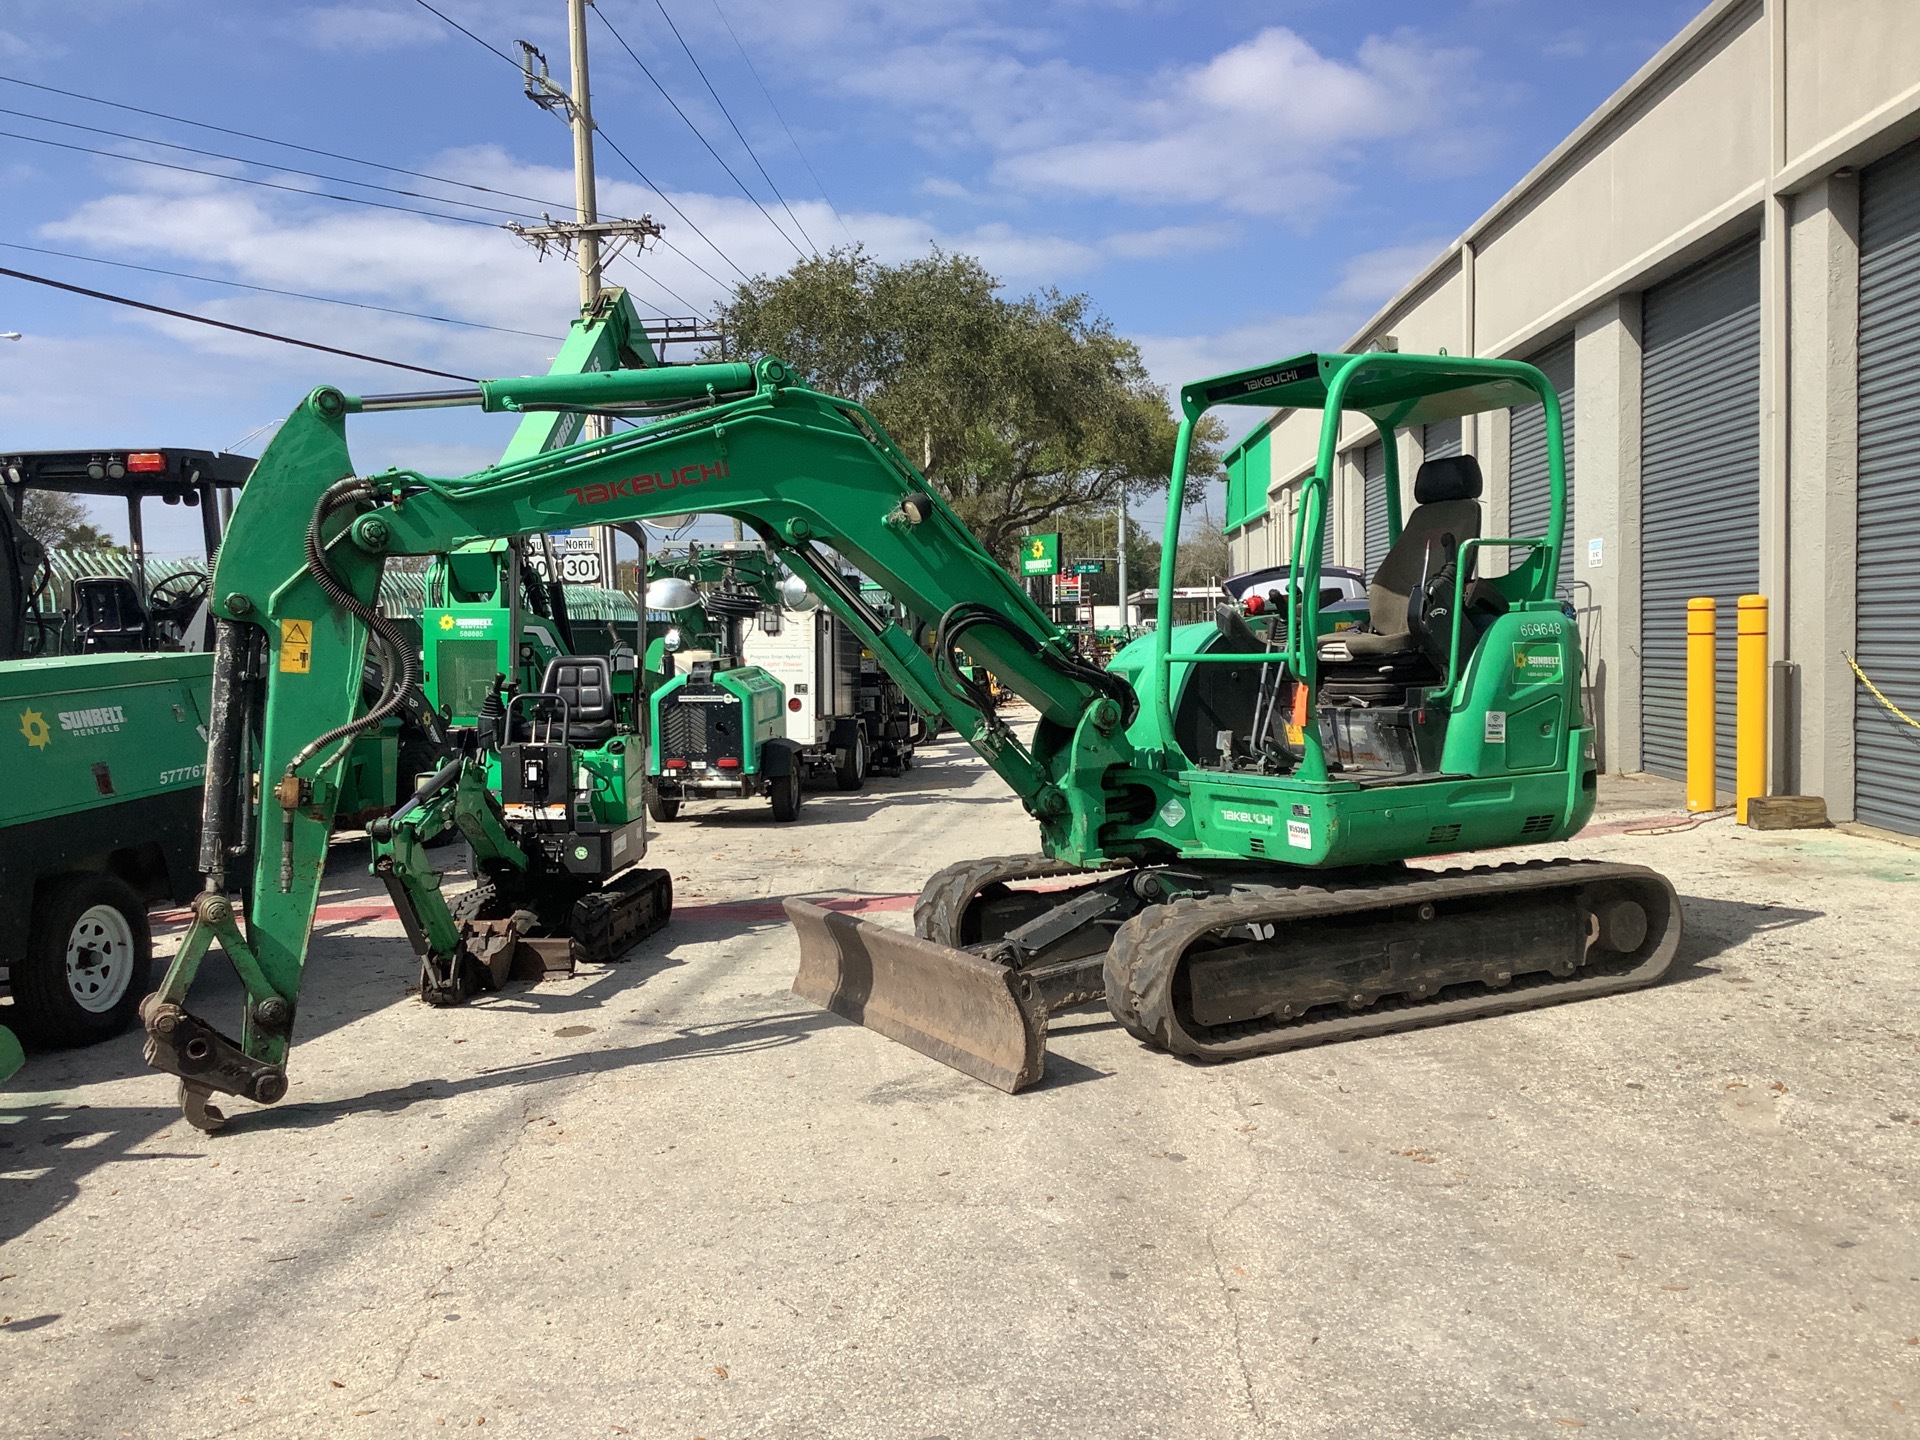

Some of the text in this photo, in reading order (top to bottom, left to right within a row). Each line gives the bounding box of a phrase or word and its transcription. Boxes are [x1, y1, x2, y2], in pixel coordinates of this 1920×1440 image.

[1244, 369, 1298, 391] TAKEUCHI
[565, 459, 731, 506] TAKEUCHI
[566, 540, 593, 550] NORTH
[567, 560, 595, 576] 301
[1520, 622, 1562, 637] 669648
[1527, 655, 1560, 665] SUNBELT
[58, 706, 126, 731] SUNBELT
[73, 724, 121, 738] RENTALS
[160, 763, 207, 785] 577767
[1221, 809, 1274, 826] TAKEUCHI
